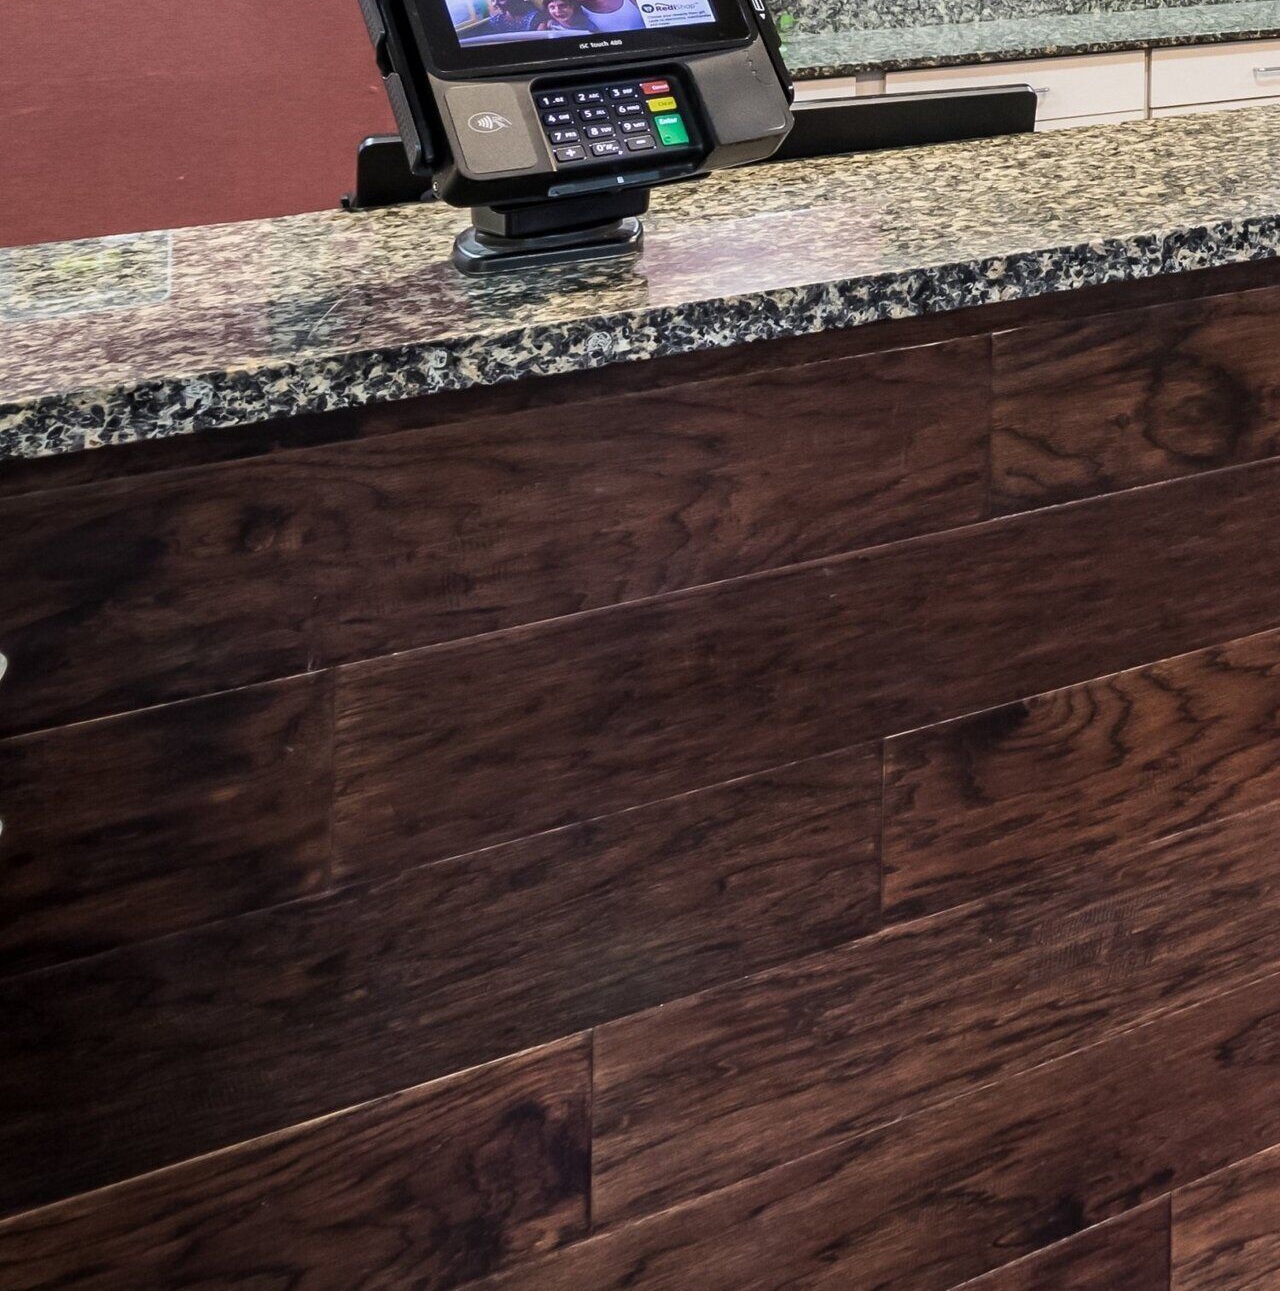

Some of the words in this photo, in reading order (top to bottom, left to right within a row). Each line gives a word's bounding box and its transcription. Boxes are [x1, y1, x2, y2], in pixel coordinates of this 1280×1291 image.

[612, 88, 620, 97] 3
[543, 97, 549, 105] 1
[578, 93, 586, 101] 2
[618, 105, 626, 113] 6
[548, 114, 556, 122] 4
[584, 110, 592, 118] 5
[623, 122, 631, 131] 9
[590, 127, 599, 136] 8
[554, 132, 562, 140] 7
